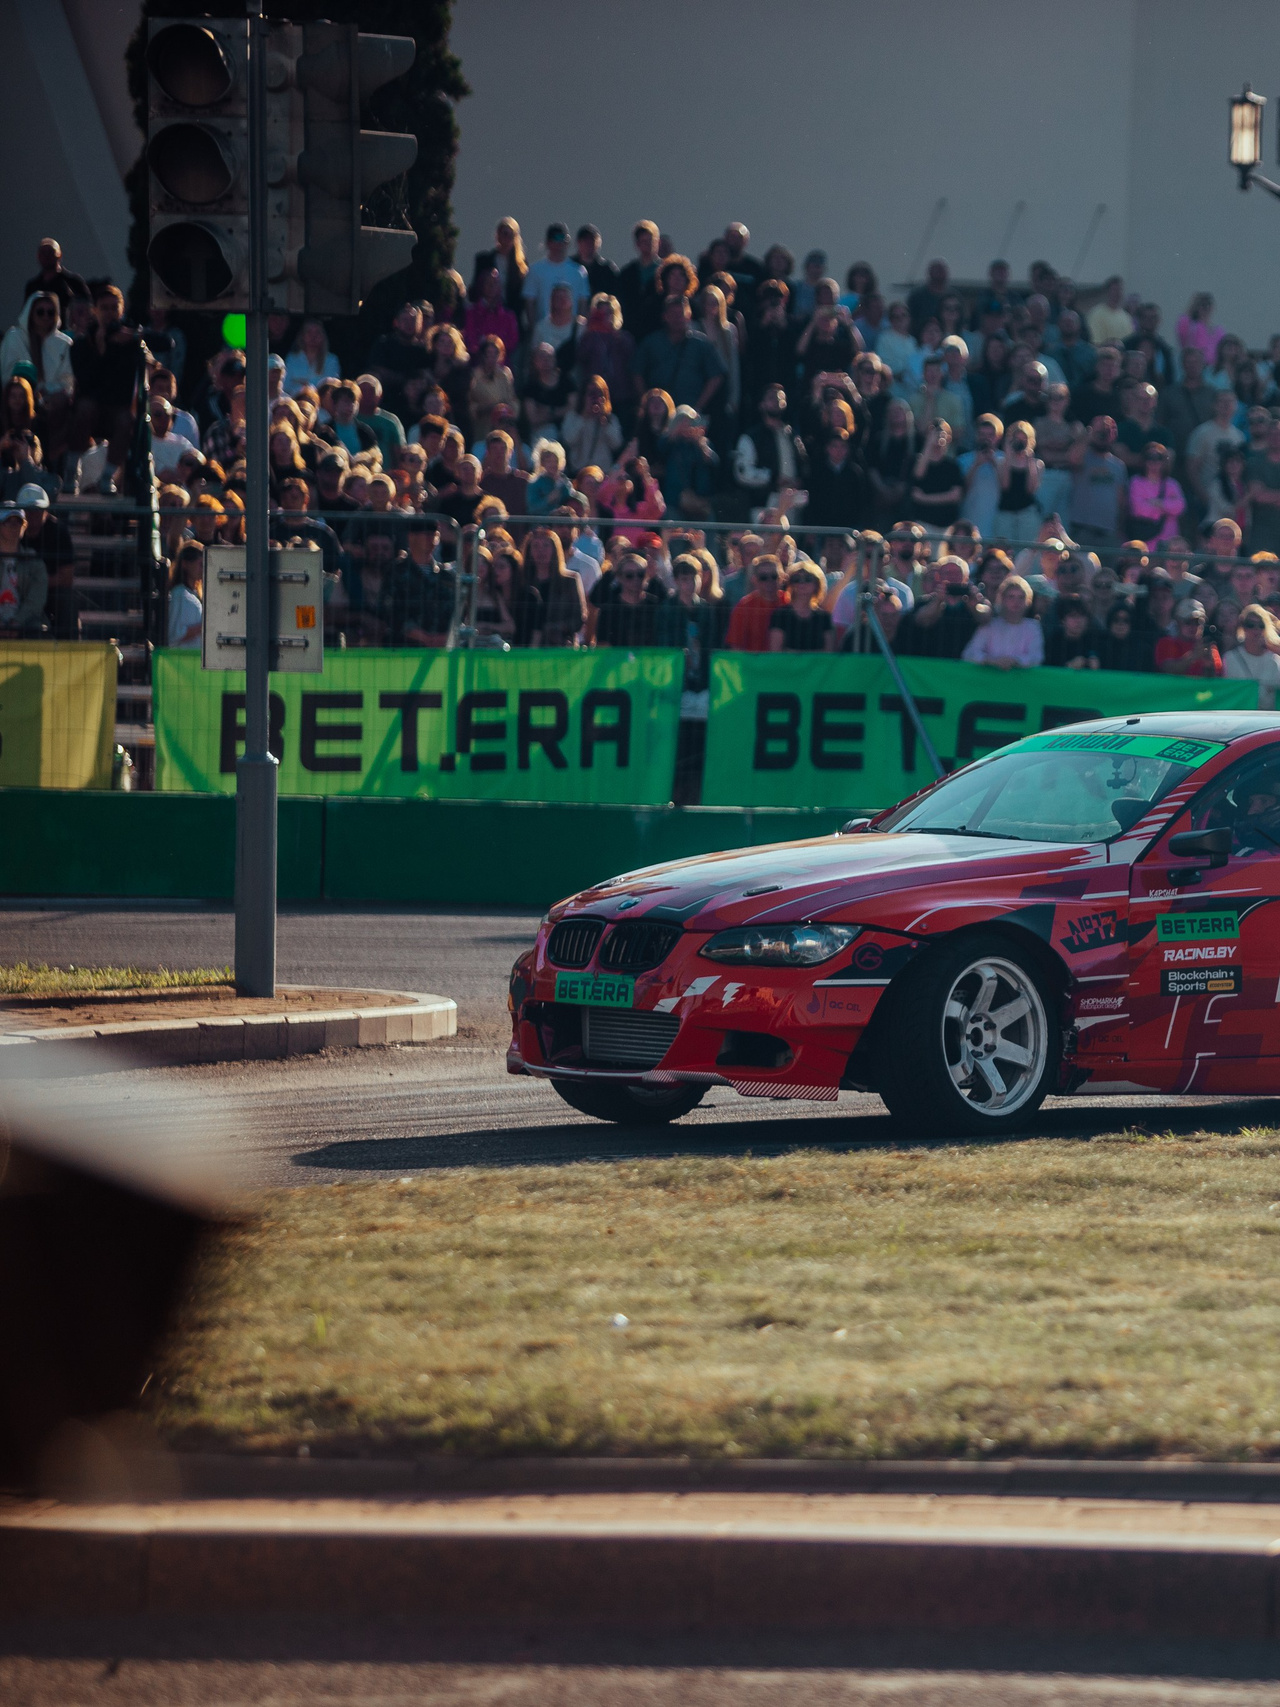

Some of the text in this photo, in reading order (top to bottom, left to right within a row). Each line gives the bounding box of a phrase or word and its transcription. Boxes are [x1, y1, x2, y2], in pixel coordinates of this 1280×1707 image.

[753, 691, 1105, 774] BET.E
[1172, 741, 1205, 753] BET
[1161, 916, 1236, 934] BET.ERA
[1163, 946, 1237, 962] RACING.BY
[1168, 969, 1227, 982] Blockchain
[558, 979, 629, 1002] BET.ERA
[1168, 980, 1206, 993] Sports
[829, 1000, 844, 1010] QC
